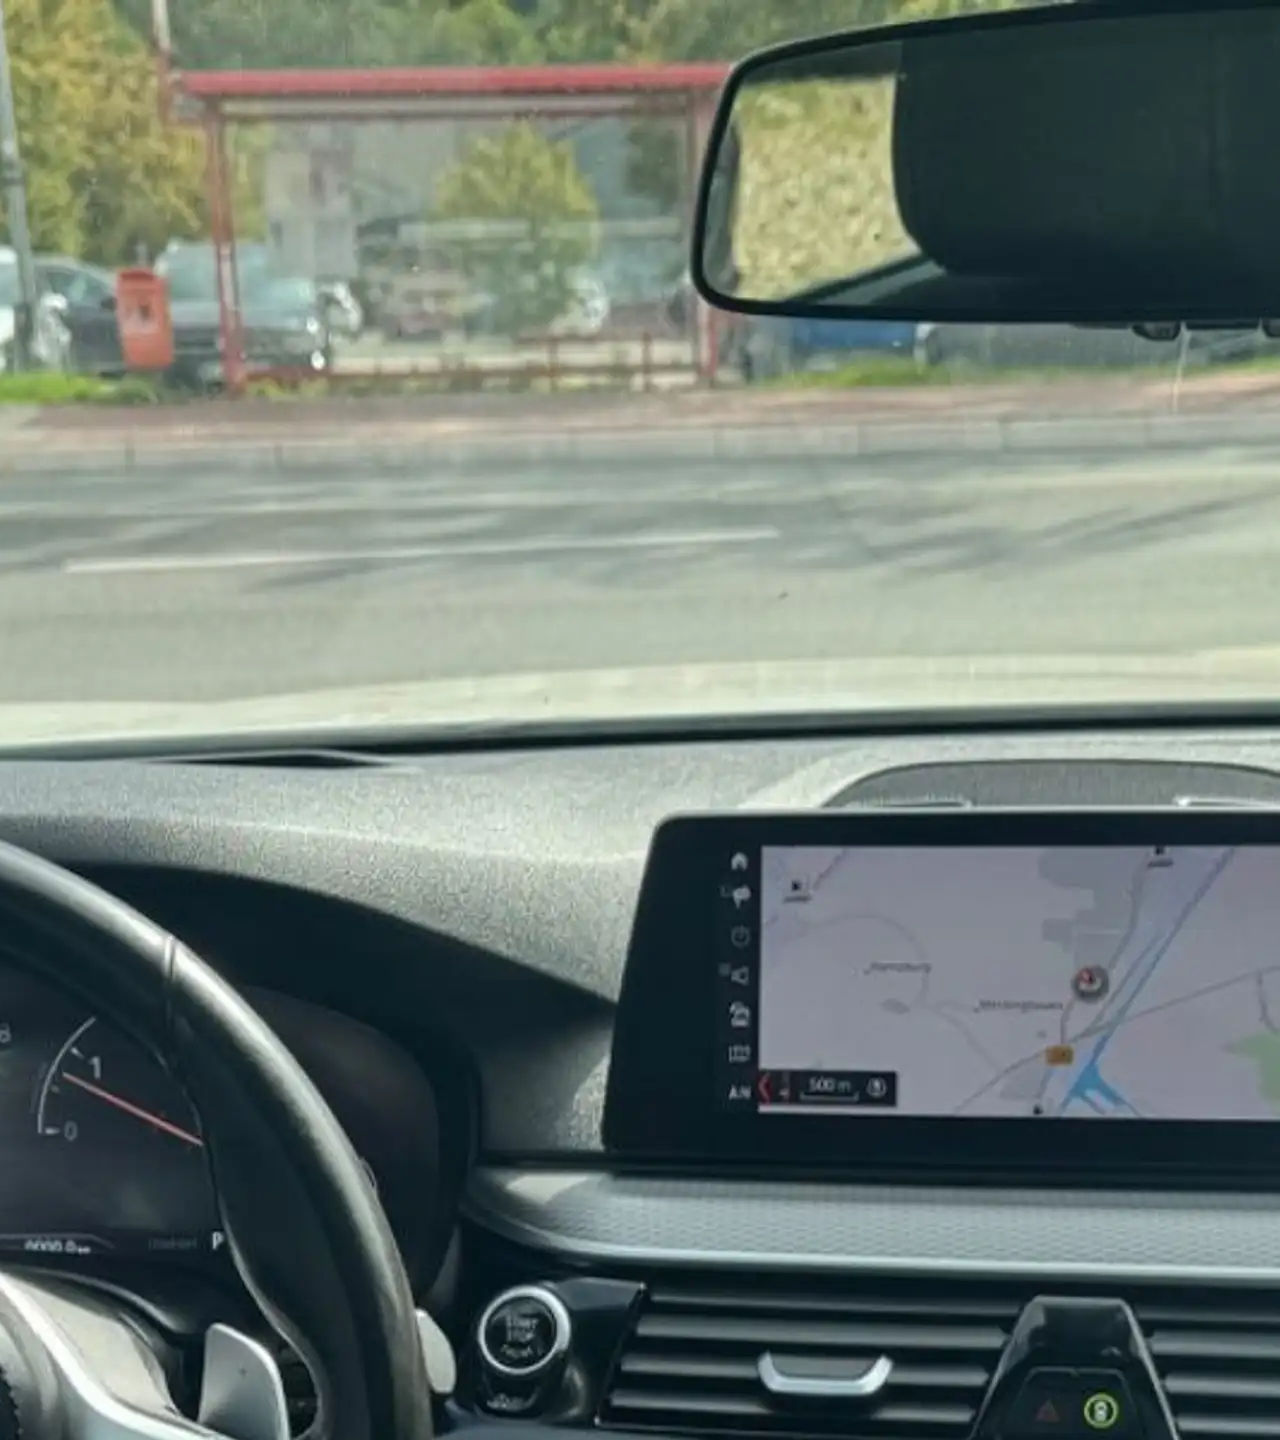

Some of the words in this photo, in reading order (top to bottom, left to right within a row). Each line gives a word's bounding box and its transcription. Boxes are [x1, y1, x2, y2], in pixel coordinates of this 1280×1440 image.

[89, 1056, 102, 1080] 1
[64, 1121, 78, 1141] 0
[211, 1231, 224, 1250] P
